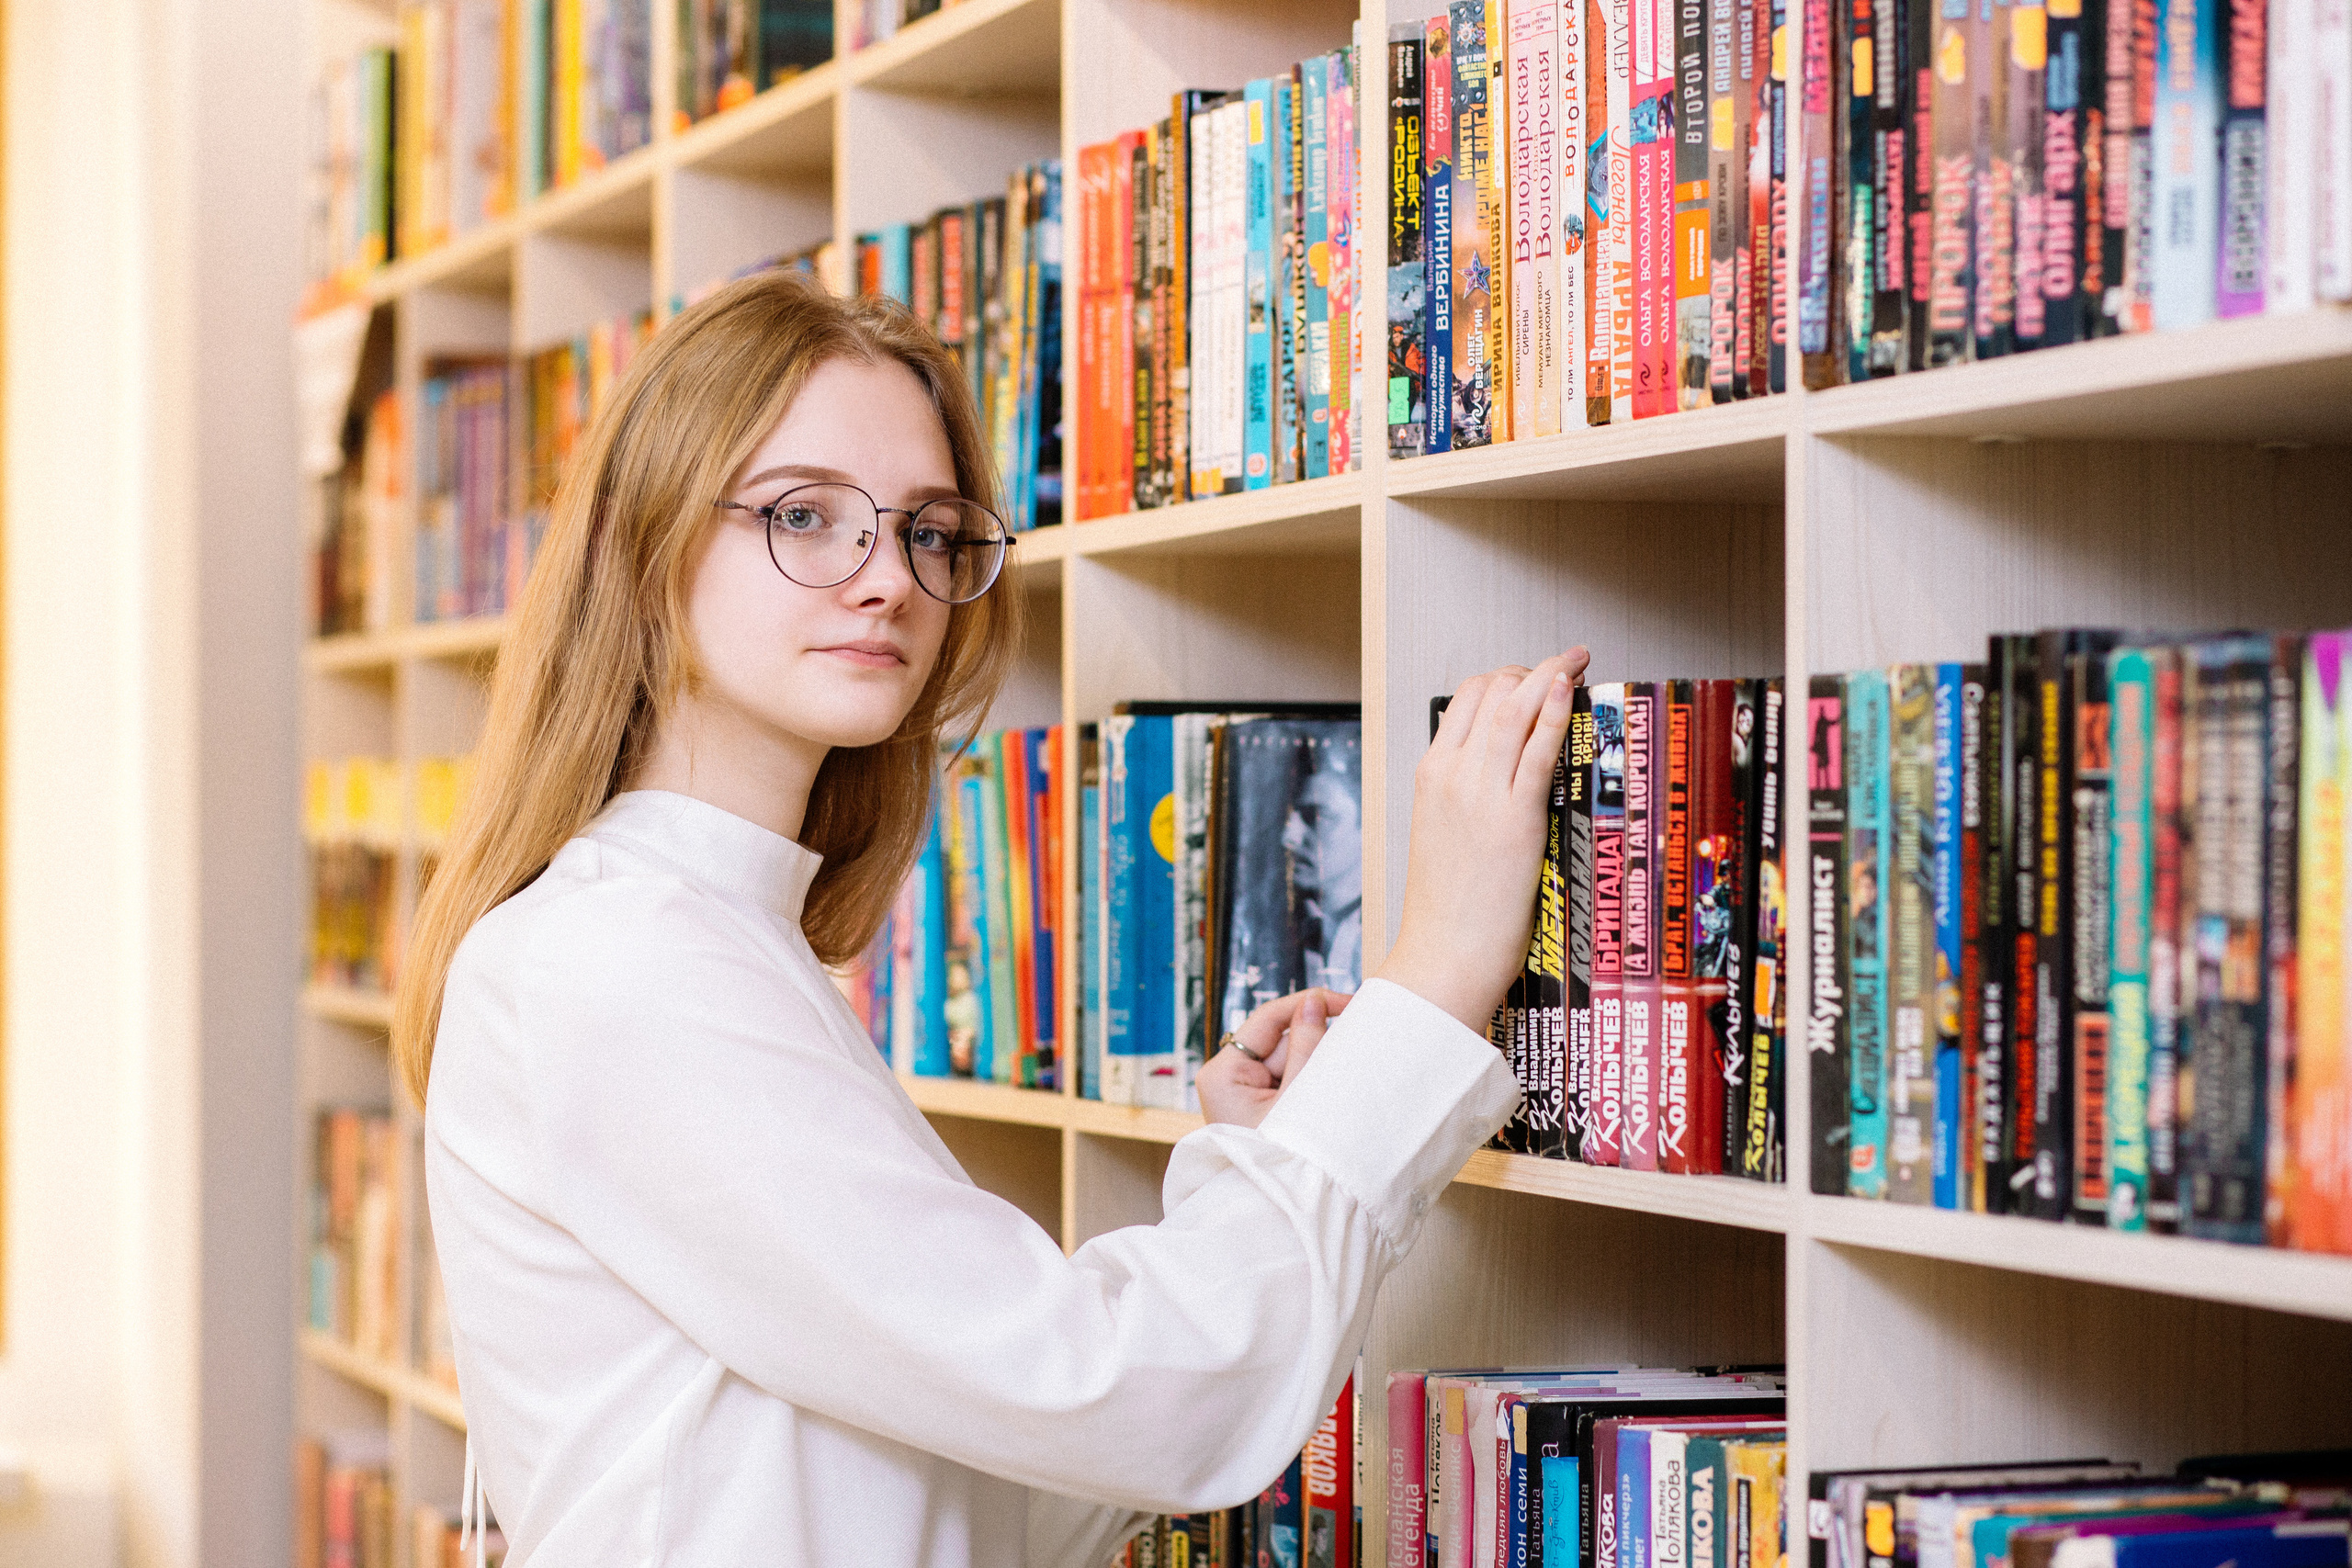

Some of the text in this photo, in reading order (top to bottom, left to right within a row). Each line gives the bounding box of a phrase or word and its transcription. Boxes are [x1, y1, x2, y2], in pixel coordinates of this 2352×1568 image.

[1613, 0, 1629, 78] ЕЛЛЕР
[1640, 28, 1649, 62] ДЕВЯТЬ
[1665, 37, 1673, 57] КАК
[1711, 22, 1731, 93] АНДРЕЙ
[1456, 108, 1473, 182] НИКТО,
[1679, 52, 1705, 144] ВТОРОЙ
[1394, 116, 1405, 247] «РОДИНА»
[1407, 116, 1419, 230] ОБЪЕКТ
[1469, 103, 1489, 231] КРОМЕ НАС!
[1514, 55, 1532, 265] Володарская
[1534, 49, 1555, 260] Володарская
[1426, 240, 1435, 292] Валерия
[1434, 183, 1451, 331] ВЕРБИНИНА
[1611, 125, 1632, 400] Легенды АРБАТА
[1639, 153, 1653, 347] ОЛЬГА ВОЛОДАРСКАЯ
[1659, 149, 1671, 344] ОЛЬГА ВОЛОДАРСКАЯ
[1490, 202, 1503, 394] ИРИНА ВОЛКОВА
[1521, 310, 1530, 355] СИРЕНЫ
[1567, 291, 1574, 307] ЛИ
[1567, 310, 1574, 323] ТО
[1567, 327, 1576, 366] АНГЕЛ,
[1711, 257, 1735, 385] ПРОРОК
[1429, 344, 1439, 446] История одного
[1436, 355, 1446, 434] замужества
[1467, 333, 1476, 367] ОЛЕГ
[1474, 309, 1485, 389] ВЕРЕЩАГИН
[1567, 369, 1574, 384] ЛИ
[1567, 388, 1574, 401] ТО
[1582, 711, 1593, 764] КРОВИ
[1571, 772, 1582, 801] МЫ
[1549, 812, 1560, 860] законе
[1623, 703, 1647, 970] А ЖИЗНЬ ТАК КОРОТКА!
[1662, 711, 1689, 971] БРАТ, ОСТАНЬСЯ В ЖИВЫХ
[1542, 856, 1565, 983] МЕНТ
[1570, 809, 1591, 987] КОМАНДА
[1597, 836, 1623, 972] БРИГАДА
[1806, 854, 1843, 1055] Журналист
[1528, 1008, 1541, 1091] Владимир
[1541, 1006, 1553, 1091] Владимир
[1567, 1007, 1579, 1094] Владимир
[1591, 998, 1603, 1102] Владимир
[1622, 999, 1634, 1106] Владимир
[1658, 999, 1670, 1108] Владимир
[1723, 942, 1745, 1086] КОЛЫЧЕВ
[1540, 1006, 1564, 1132] КОЛЫЧЕВ
[1591, 998, 1621, 1153] КОЛЫЧЕВ
[1622, 999, 1651, 1156] КОЛЫЧЕВ
[1657, 1000, 1688, 1158] КОЛЫЧЕВ
[1745, 1033, 1770, 1173] КОЛЫЧЕВ
[1496, 1439, 1507, 1506] любовь
[1517, 1467, 1529, 1524] семи
[1654, 1479, 1667, 1548] Татьяна
[1529, 1488, 1541, 1561] Татьяна
[1578, 1483, 1590, 1561] Татьяна
